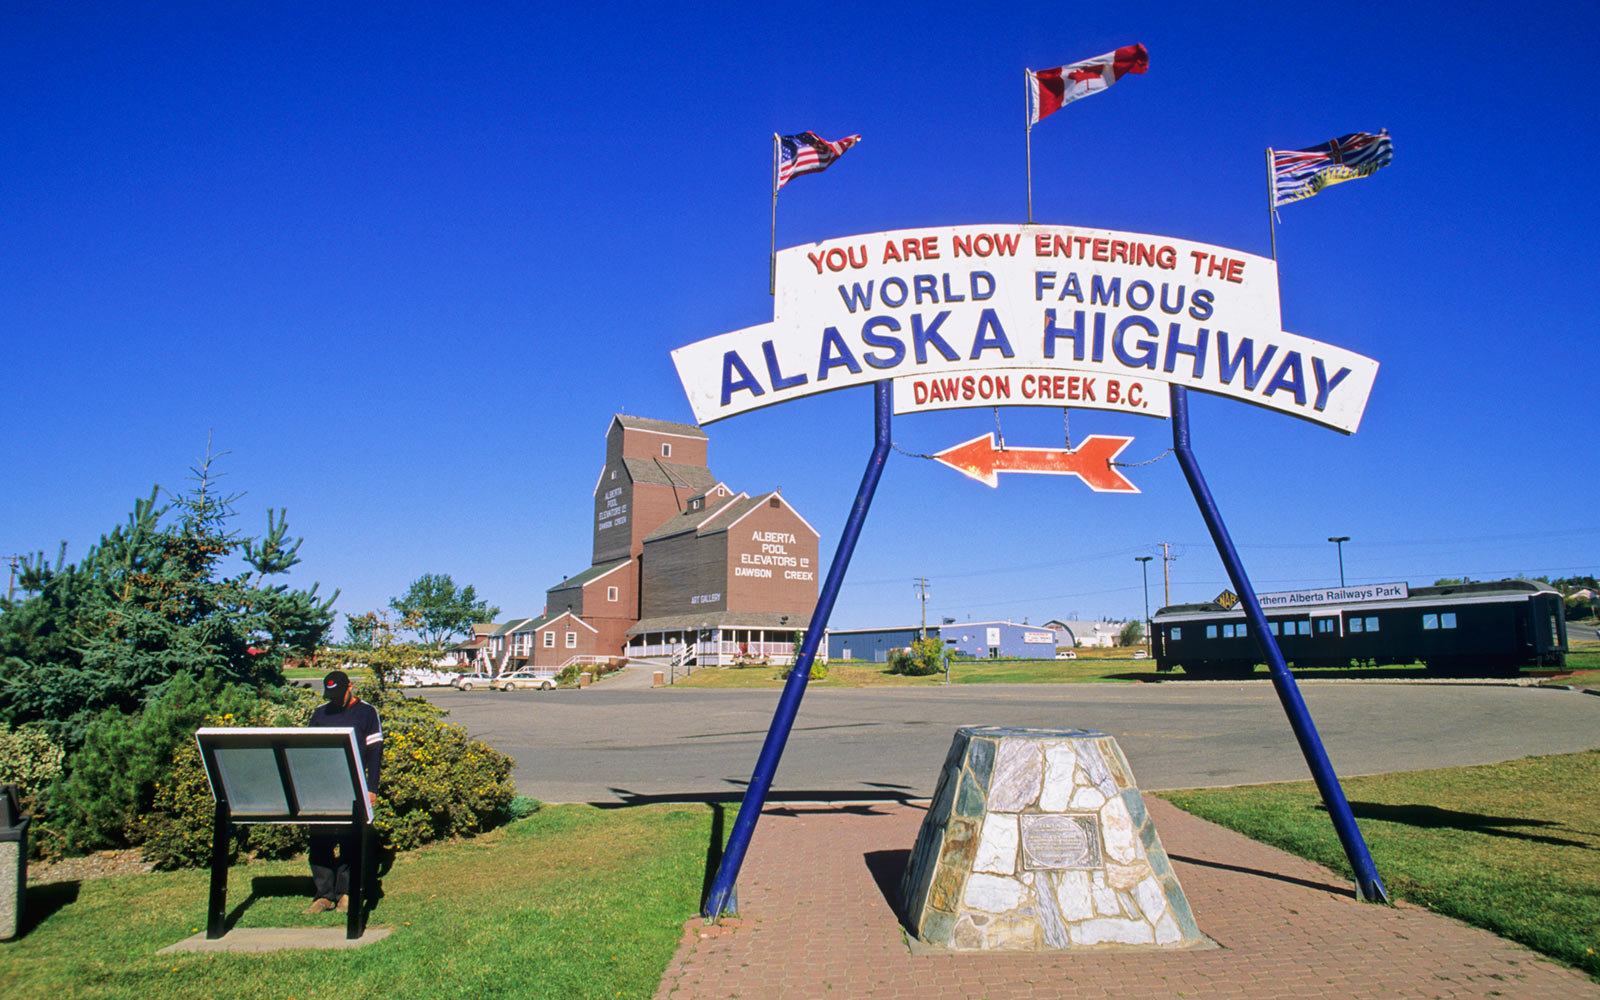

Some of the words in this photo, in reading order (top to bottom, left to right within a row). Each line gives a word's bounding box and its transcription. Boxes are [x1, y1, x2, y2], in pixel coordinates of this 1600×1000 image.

[808, 245, 868, 275] YOU
[882, 236, 940, 264] ARE
[952, 233, 1021, 258] NOW
[1034, 234, 1177, 271] ENTERING
[1190, 250, 1246, 284] THE
[838, 270, 996, 314] WORLD
[1035, 271, 1215, 321] FAMOUS
[720, 308, 1015, 407] ALASKA
[1043, 308, 1352, 413] HIGHWAY
[914, 375, 1011, 405] DAWSON
[1021, 375, 1096, 402] CREEK
[751, 530, 797, 544] ALBERTA
[761, 543, 788, 555] POOL
[741, 553, 797, 567] ELEVATORS
[735, 566, 772, 578] DAWSON
[784, 570, 814, 581] CREEK
[1290, 592, 1324, 603] Alberta
[1326, 589, 1373, 601] Railways
[1375, 586, 1401, 597] Park
